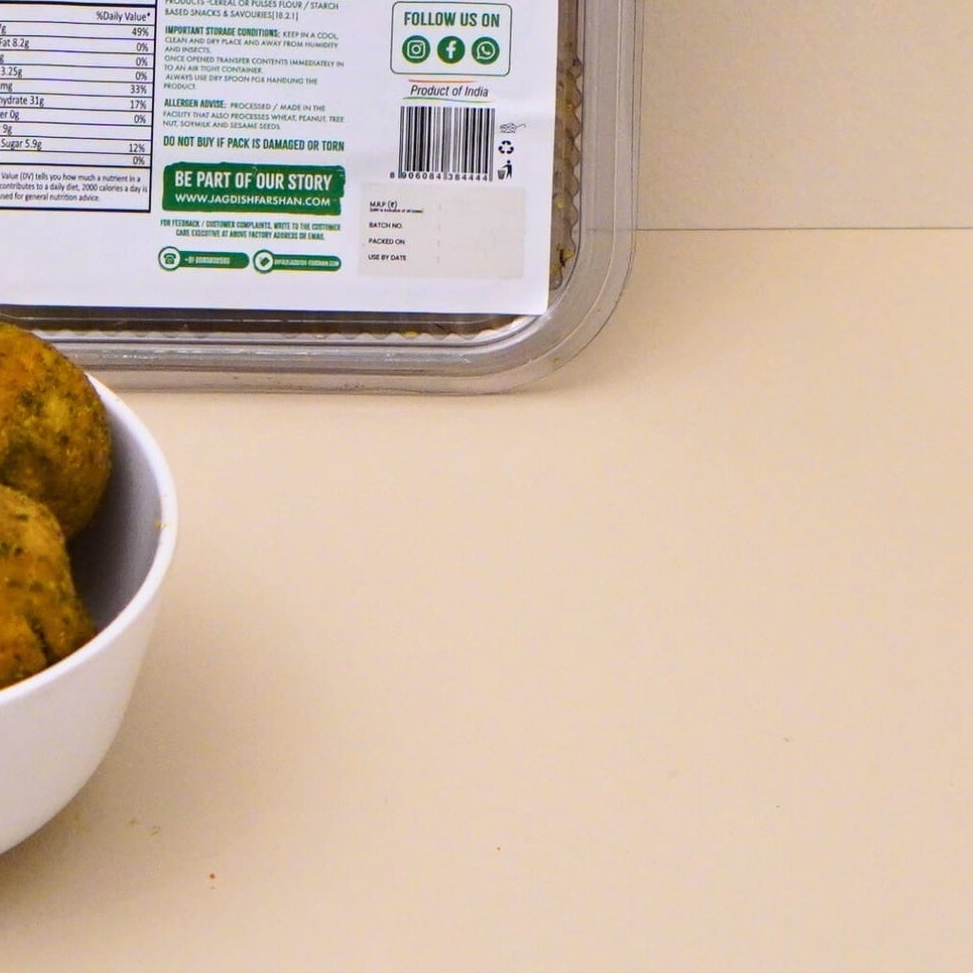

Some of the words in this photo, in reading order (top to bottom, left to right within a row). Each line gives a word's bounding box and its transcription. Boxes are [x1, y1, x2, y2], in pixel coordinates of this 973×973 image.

[310, 2, 339, 10] STARCH
[96, 11, 123, 22] %Daily
[404, 12, 456, 27] FOLLOW
[460, 13, 477, 27] US
[482, 13, 500, 27] ON
[132, 27, 149, 37] 49%
[165, 26, 204, 35] IMPORTANT
[205, 28, 235, 36] STORAGE
[237, 29, 280, 37] CONDITIONS:
[12, 38, 29, 49] 8.2g
[136, 43, 149, 52] 0%
[135, 57, 148, 67] 0%
[1, 67, 23, 78] 3.25g
[135, 71, 148, 80] 0%
[130, 85, 147, 94] 33%
[410, 85, 450, 98] Product
[452, 86, 462, 96] of
[464, 87, 489, 97] India
[30, 96, 44, 107] 31g
[130, 100, 147, 109] 17%
[9, 110, 20, 121] 0g
[134, 115, 146, 124] 0%
[2, 124, 13, 135] 9g
[1, 138, 24, 149] Sugar
[25, 139, 42, 150] 5.9g
[129, 144, 146, 154] 12%
[163, 136, 175, 146] DO
[177, 137, 194, 147] NOT
[197, 137, 214, 147] BUY
[217, 138, 224, 148] IF
[227, 138, 249, 148] PACK
[252, 139, 261, 149] IS
[263, 139, 305, 150] DAMAGED
[307, 141, 319, 151] OR
[322, 141, 345, 151] TORN
[132, 156, 145, 166] 0%
[175, 171, 192, 187] BE
[197, 172, 230, 188] PART
[235, 173, 251, 188] OF
[256, 173, 284, 190] OUR
[288, 174, 331, 191] STORY
[175, 194, 331, 206] WWW.JAGDISHFARSHAN.COM
